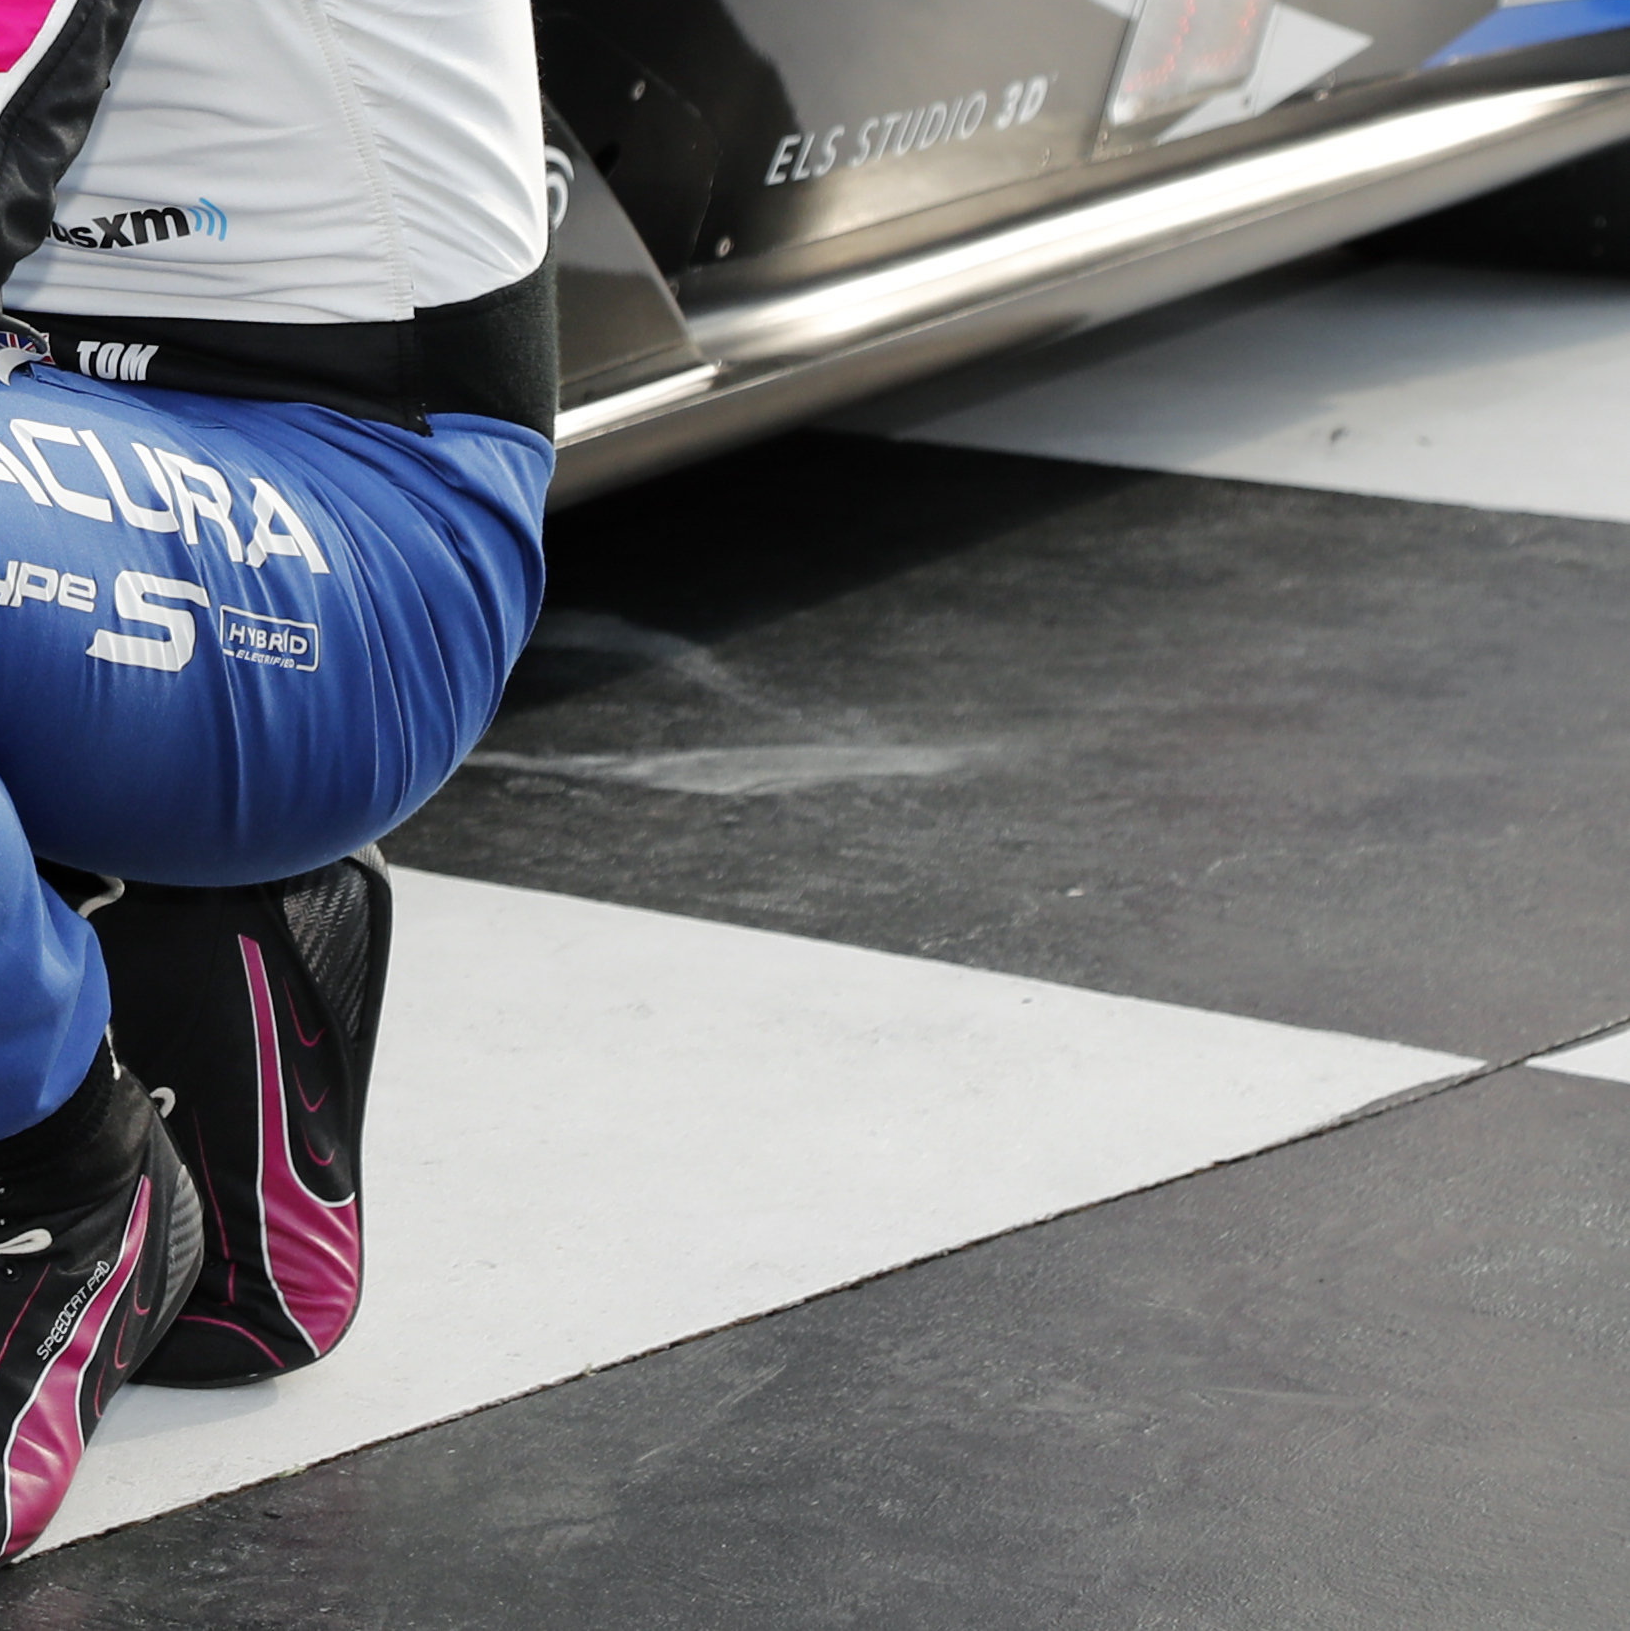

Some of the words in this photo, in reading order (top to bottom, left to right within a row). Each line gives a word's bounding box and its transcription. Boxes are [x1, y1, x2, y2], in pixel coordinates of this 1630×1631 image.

[764, 132, 847, 186] ELS
[848, 88, 989, 167] STUDIO
[991, 72, 1054, 131] 3D
[76, 341, 159, 381] TOM
[85, 569, 211, 672] S
[229, 622, 309, 655] HYBRID
[36, 1286, 87, 1361] SPEEDCAT
[86, 1260, 111, 1291] PAD
